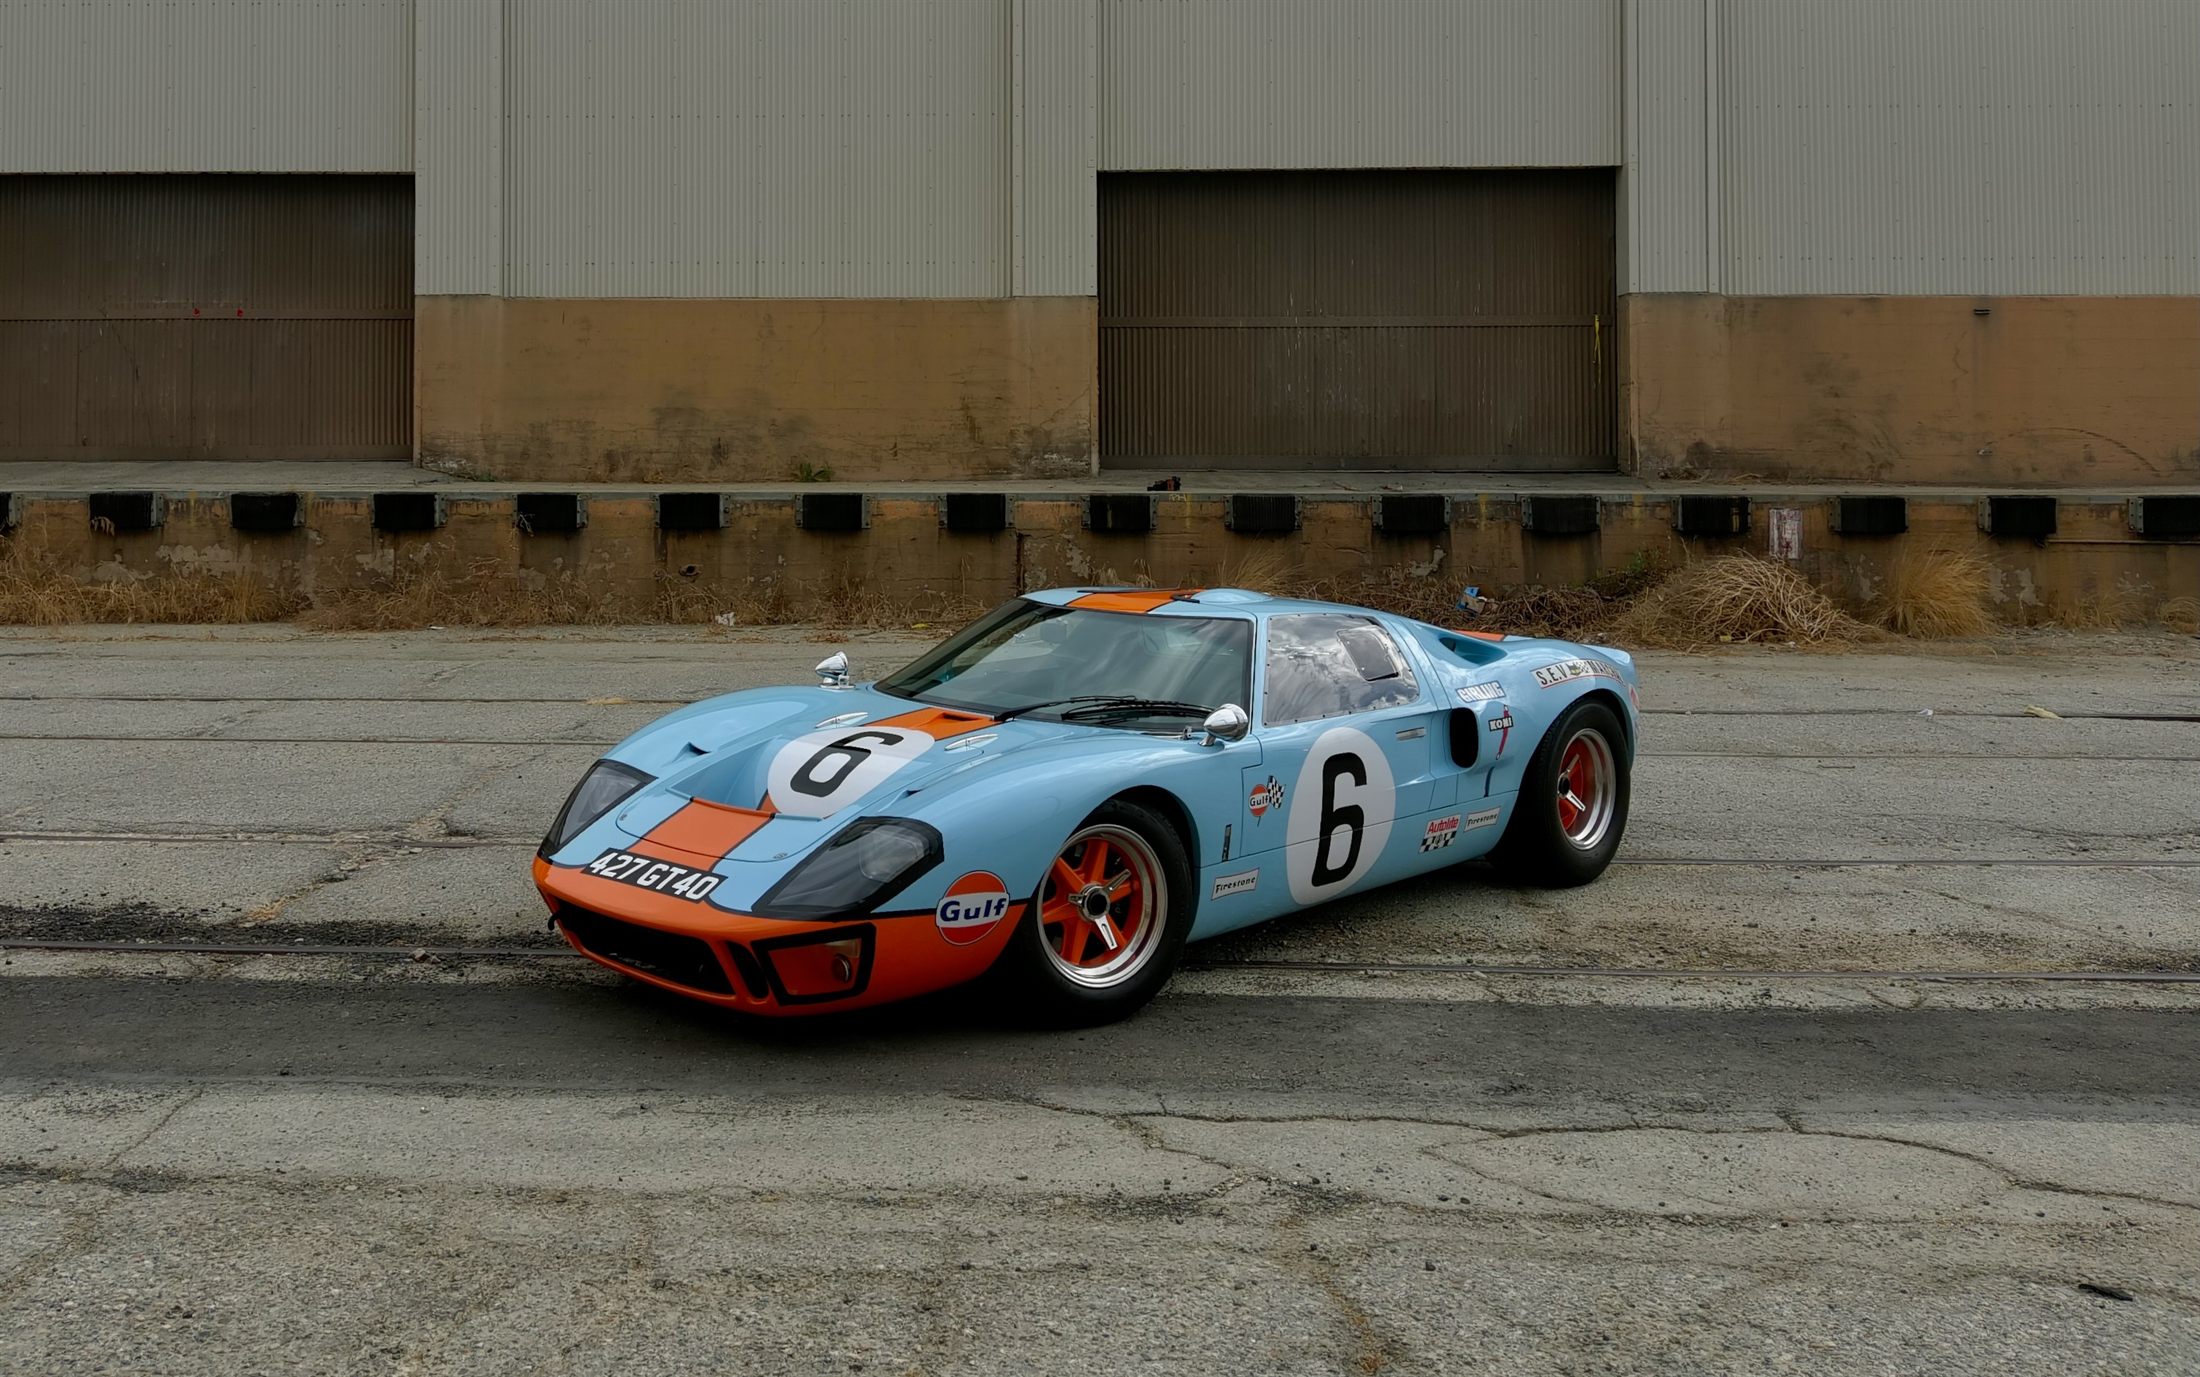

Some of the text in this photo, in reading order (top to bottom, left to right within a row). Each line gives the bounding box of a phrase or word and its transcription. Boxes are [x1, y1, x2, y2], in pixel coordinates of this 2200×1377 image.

[1457, 682, 1504, 701] GIRLING
[1489, 717, 1512, 730] KONI
[790, 731, 904, 798] 6
[1249, 795, 1269, 807] Gulf
[1311, 752, 1367, 887] 6
[1428, 817, 1459, 833] Autolite
[1467, 813, 1498, 826] Firestone
[589, 852, 651, 880] 427
[1215, 876, 1256, 893] Firestone
[940, 898, 1007, 922] Gulf
